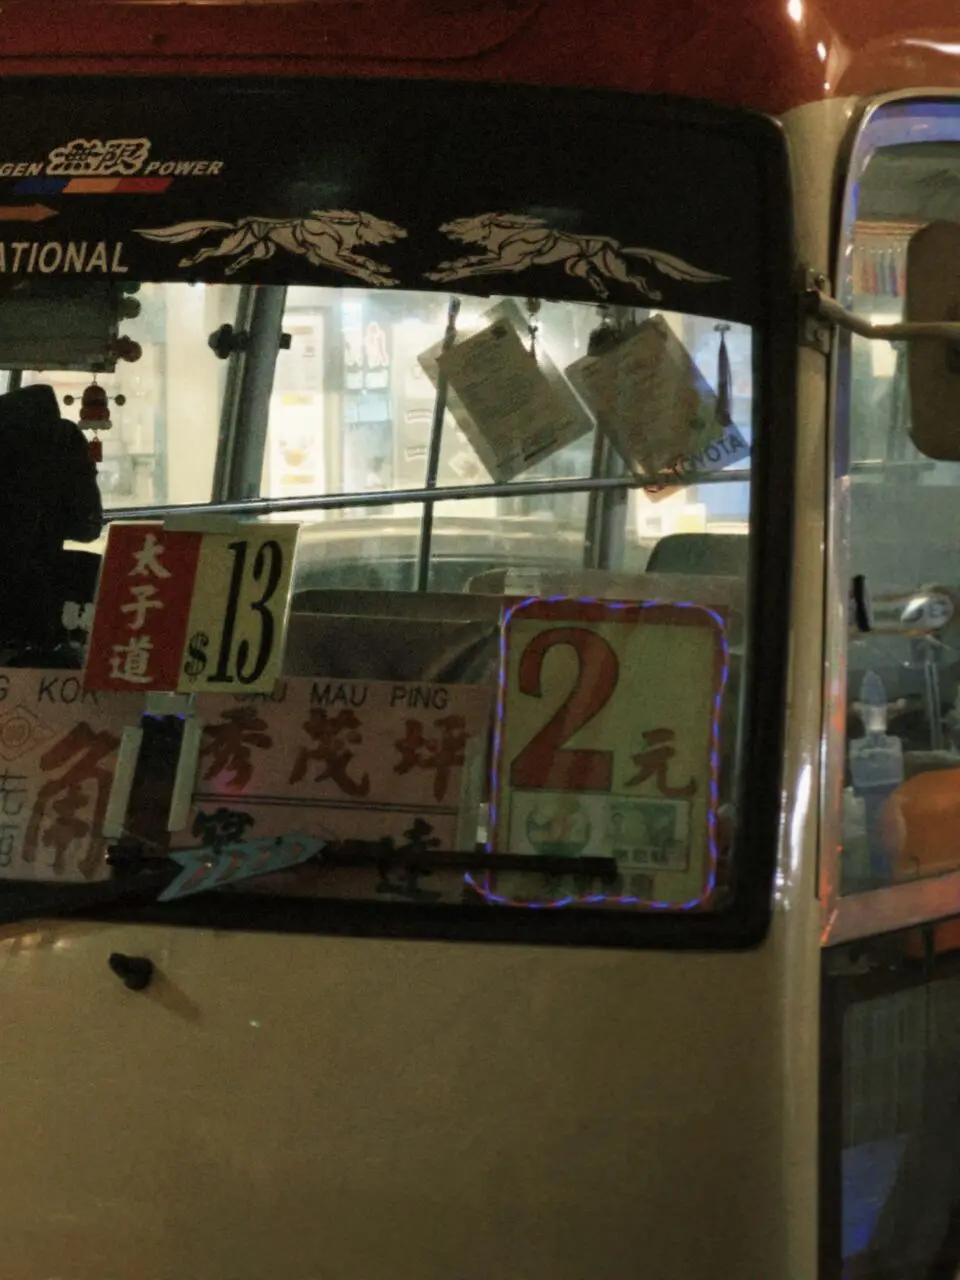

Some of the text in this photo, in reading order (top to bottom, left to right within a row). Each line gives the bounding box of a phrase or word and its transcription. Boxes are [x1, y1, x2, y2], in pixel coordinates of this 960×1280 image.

[143, 160, 225, 176] POWER
[107, 532, 172, 685] 太子道
[183, 539, 283, 685] $13
[309, 682, 368, 707] MAU
[389, 685, 449, 710] PING
[197, 707, 470, 804] 秀茂坪
